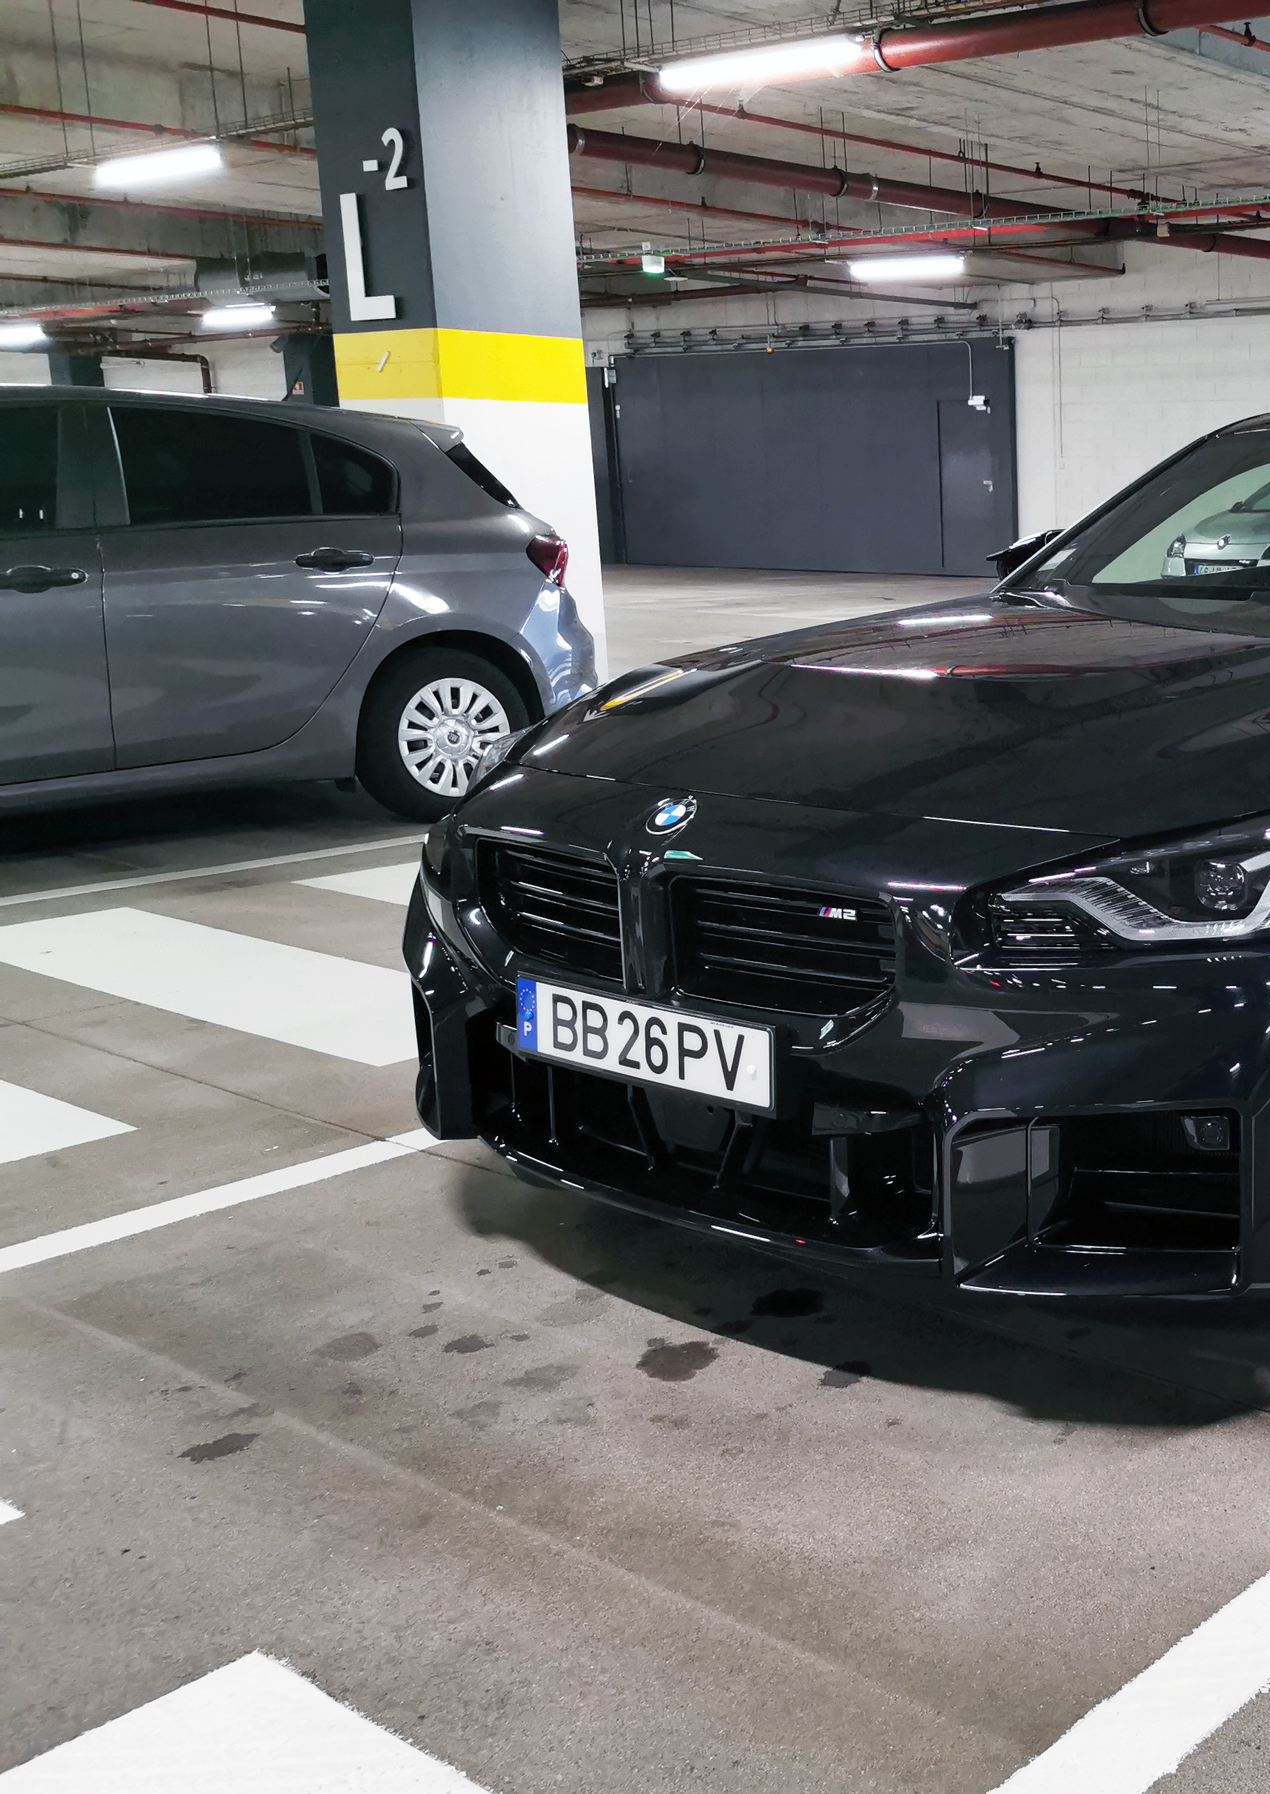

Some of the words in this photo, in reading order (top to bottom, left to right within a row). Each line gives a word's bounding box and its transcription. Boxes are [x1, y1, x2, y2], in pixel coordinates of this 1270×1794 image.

[340, 193, 396, 321] L
[829, 907, 857, 921] M2
[523, 1021, 533, 1037] P
